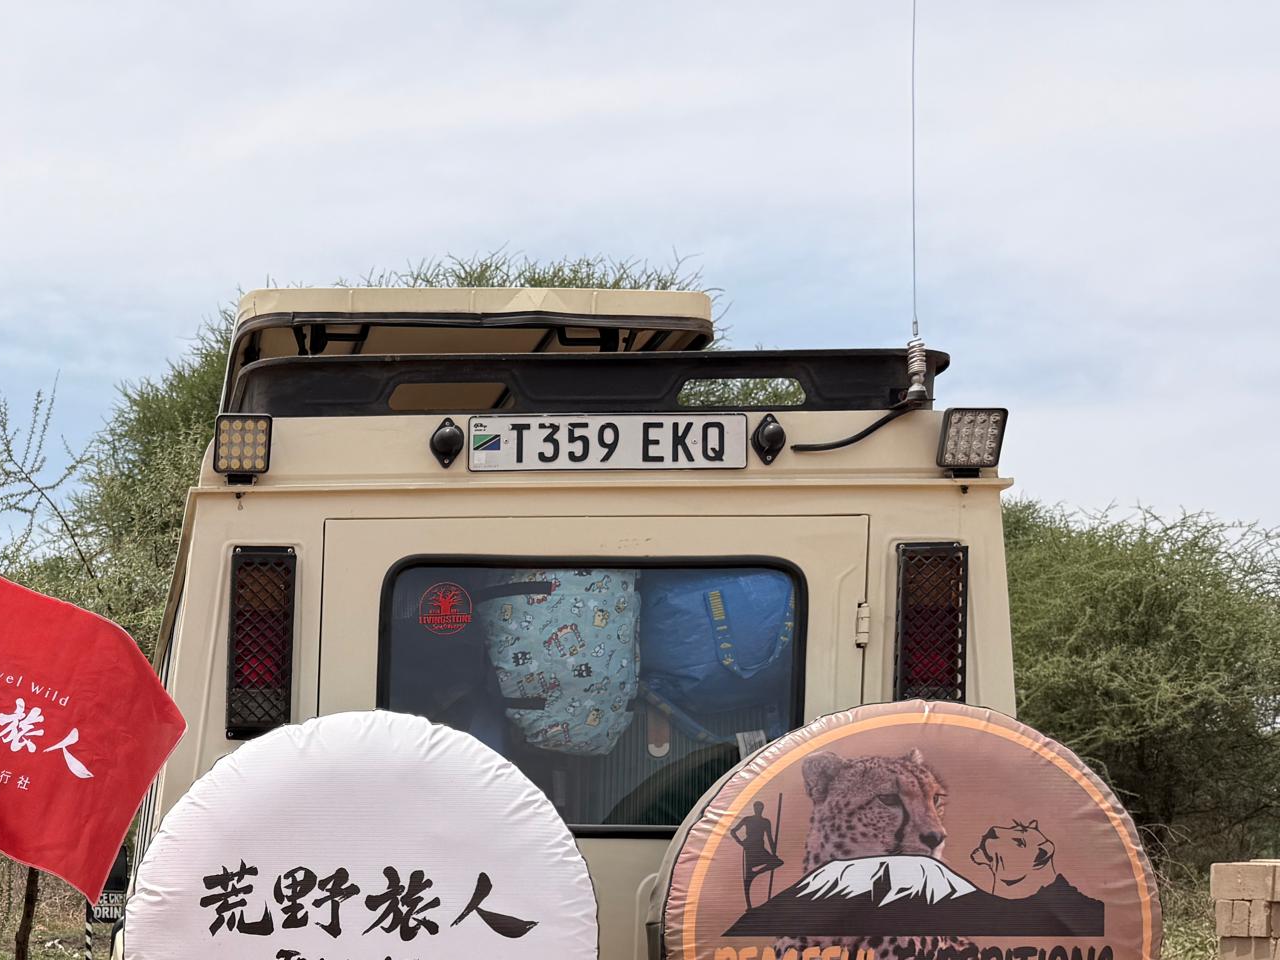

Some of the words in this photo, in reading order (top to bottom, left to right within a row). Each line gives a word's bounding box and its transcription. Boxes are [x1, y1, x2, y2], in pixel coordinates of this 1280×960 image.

[508, 421, 620, 464] T359
[641, 421, 725, 463] EKQ
[199, 859, 540, 942] 荒野旅人
